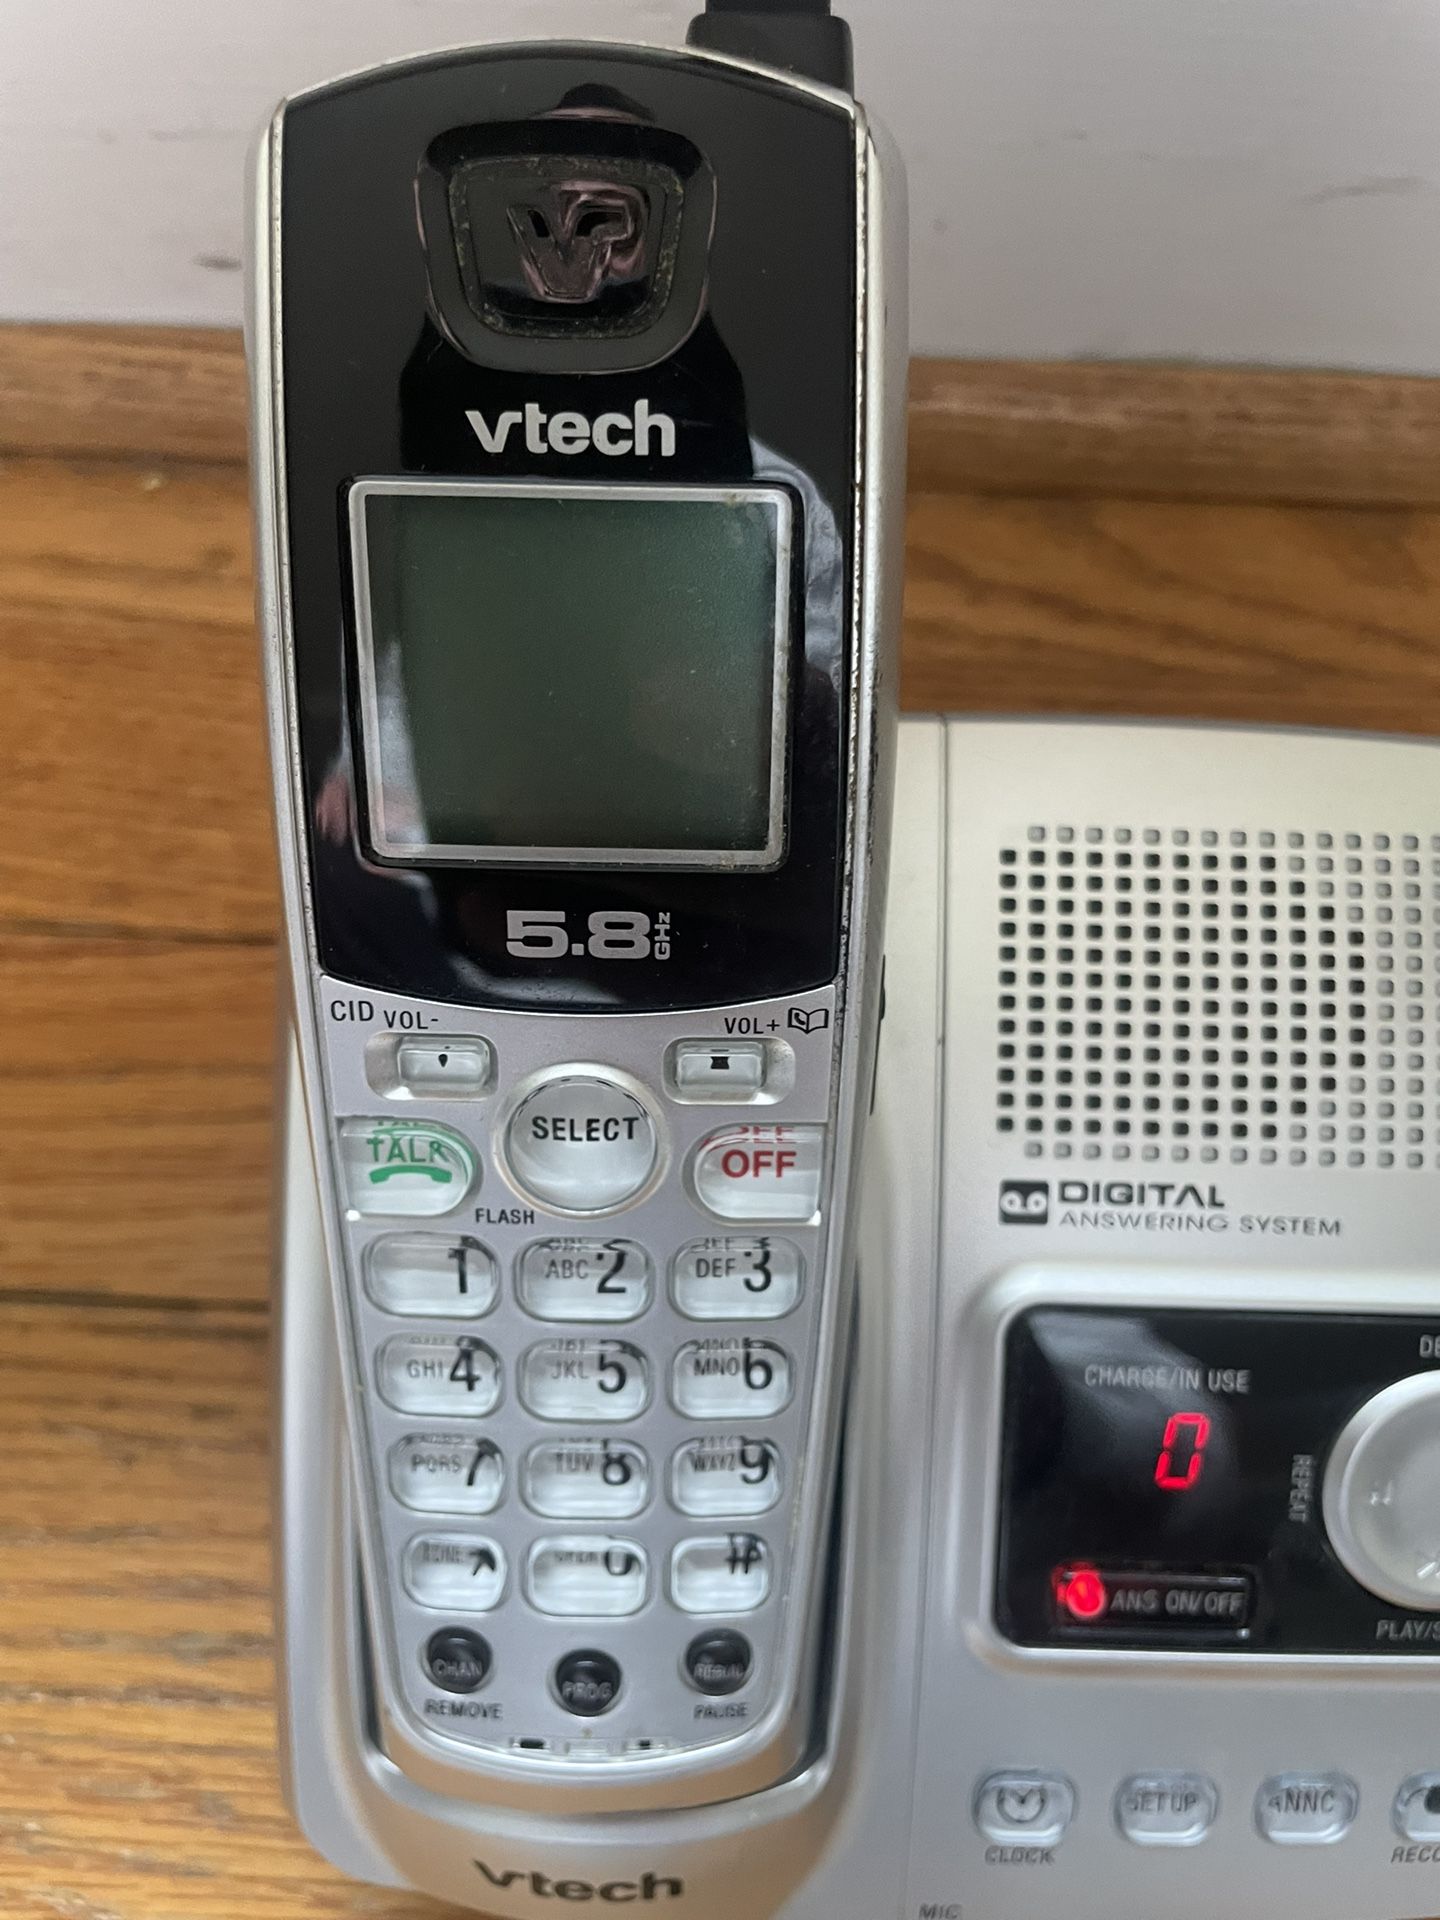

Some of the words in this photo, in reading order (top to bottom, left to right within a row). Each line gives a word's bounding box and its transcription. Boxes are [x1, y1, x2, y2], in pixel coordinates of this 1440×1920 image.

[464, 398, 677, 457] vtech
[505, 910, 651, 960] 5.8
[654, 911, 671, 960] GHz
[330, 1000, 374, 1022] CID
[383, 1010, 439, 1030] VOL-
[724, 1016, 781, 1035] VOL+
[531, 1115, 640, 1143] SELECT
[721, 1148, 798, 1179] OFF
[1058, 1181, 1226, 1209] DIGITAL
[475, 1207, 535, 1226] FLASH
[1058, 1211, 1229, 1233] ANSWERING
[1239, 1214, 1342, 1237] SYSTEM
[448, 1248, 468, 1294] 1
[545, 1259, 589, 1280] ABC
[596, 1249, 628, 1295] 2
[695, 1258, 737, 1279] DEF
[743, 1249, 773, 1293] 3
[407, 1359, 444, 1380] GHI
[449, 1350, 481, 1393] 4
[550, 1359, 589, 1380] JKL
[598, 1352, 627, 1394] 5
[743, 1350, 774, 1391] 6
[1083, 1363, 1200, 1390] CHARGE/IN
[1208, 1368, 1251, 1394] USE
[466, 1445, 500, 1487] 7
[602, 1451, 632, 1486] 8
[740, 1439, 773, 1485] 9
[1111, 1588, 1157, 1613] ANS
[1165, 1590, 1245, 1617] ON/OFF
[424, 1697, 504, 1720] REMOVE
[693, 1702, 749, 1721] PAUSE
[984, 1845, 1056, 1866] CLOCK
[472, 1858, 685, 1902] vtech
[918, 1902, 962, 1920] MIC
